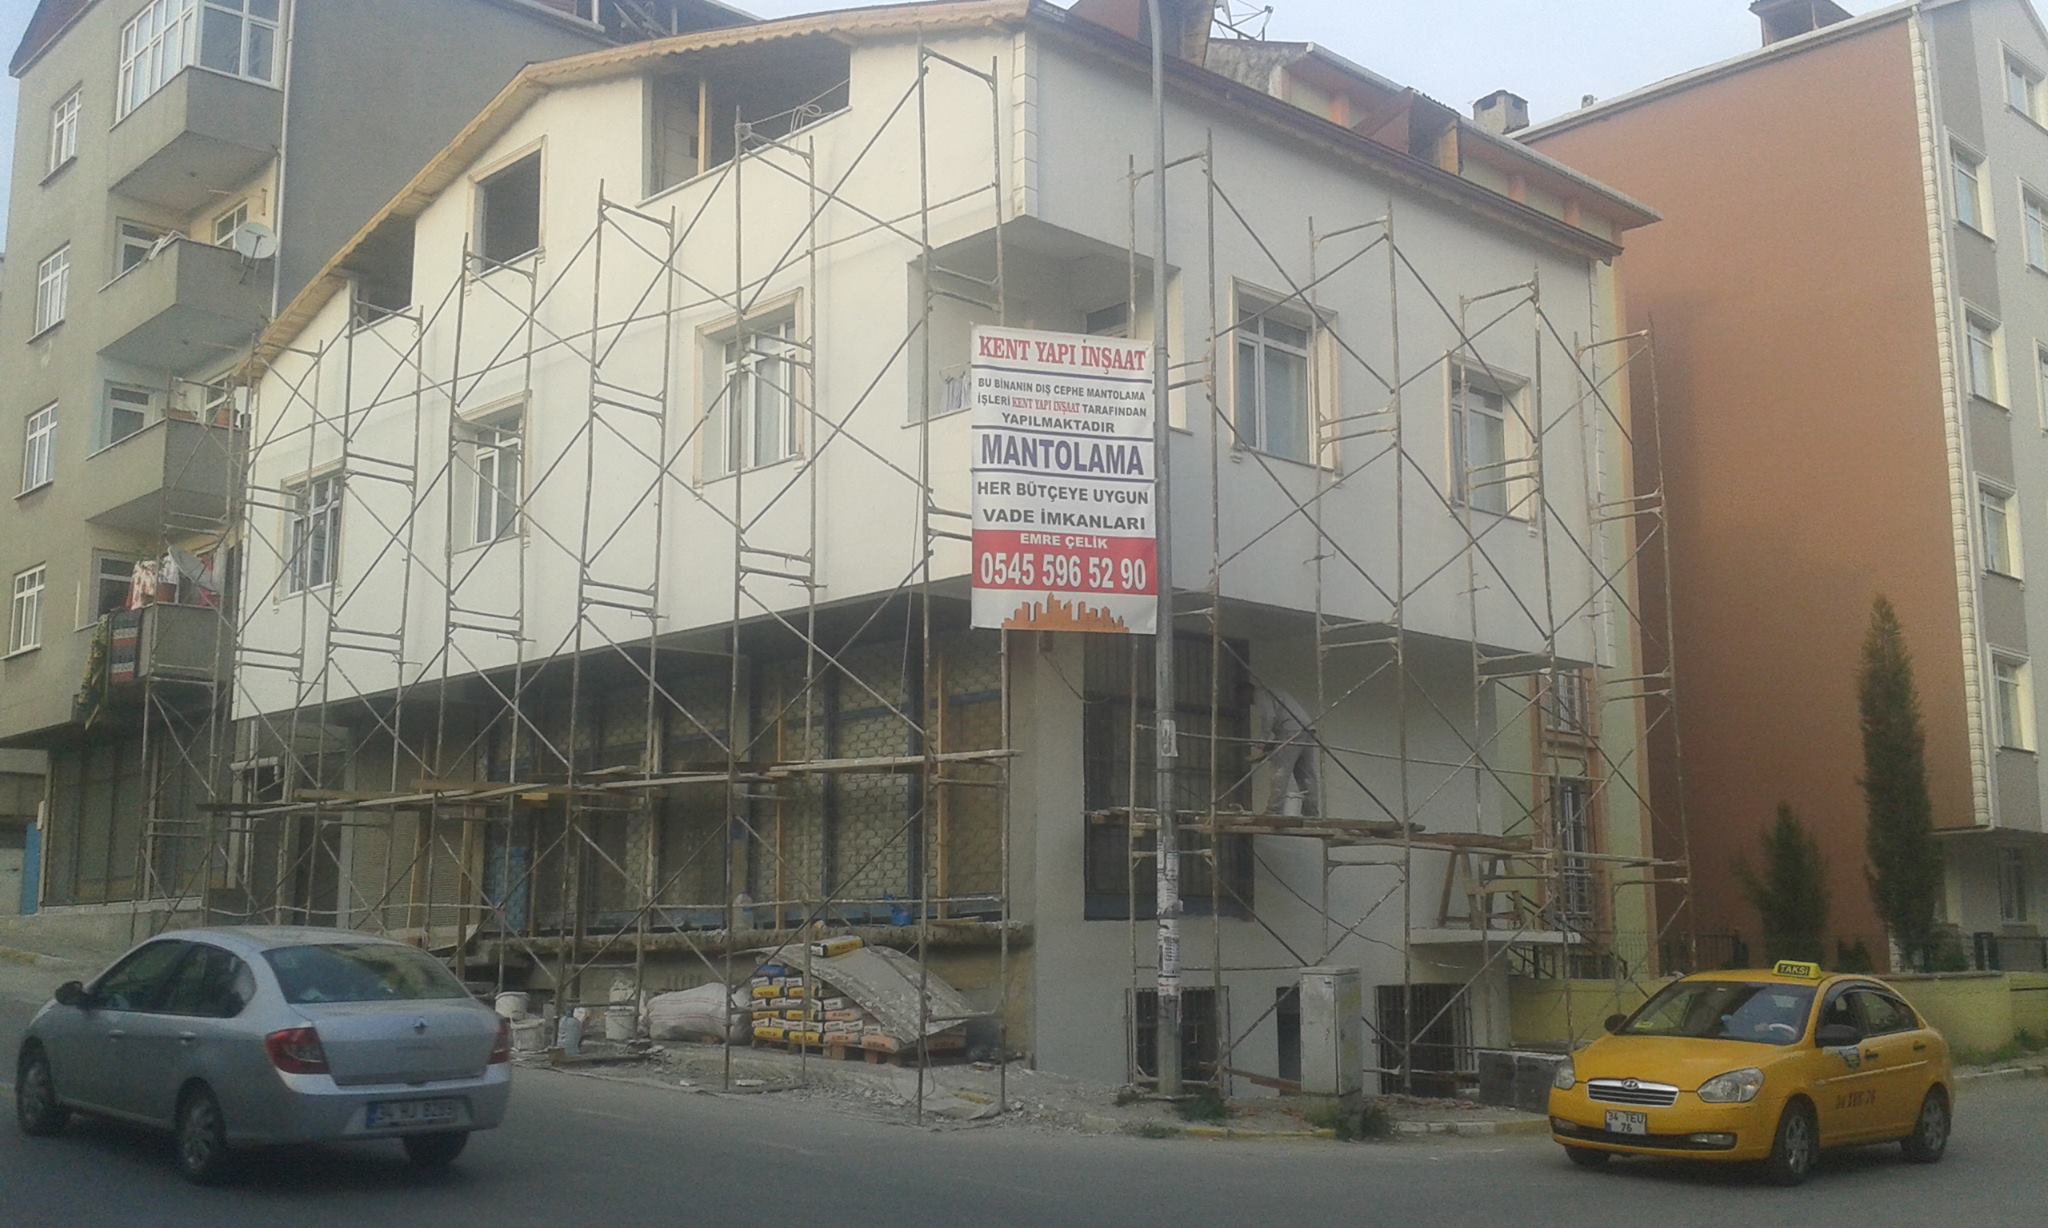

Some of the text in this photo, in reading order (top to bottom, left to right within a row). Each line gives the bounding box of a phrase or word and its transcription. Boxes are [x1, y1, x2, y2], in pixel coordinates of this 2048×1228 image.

[979, 335, 1146, 375] KENT YAPI İNŞAAT
[978, 377, 1146, 401] BU BİNANIN DIŞ CEPHE MANTOLAMA
[977, 392, 1011, 407] İŞLERİ
[1011, 396, 1033, 410] KENT
[1034, 399, 1052, 411] YAPI
[1082, 403, 1147, 417] TARAFINDAN
[1002, 412, 1115, 433] YAPILMAKTADIR
[982, 434, 1144, 476] MANTOLAMA
[977, 481, 1148, 505] HER BÜTÇEYE UYGUN
[983, 508, 1145, 530] VADE İMKANLARI
[1020, 533, 1108, 549] EMRE ÇELİK
[981, 552, 1146, 590] 0545 596 52 90
